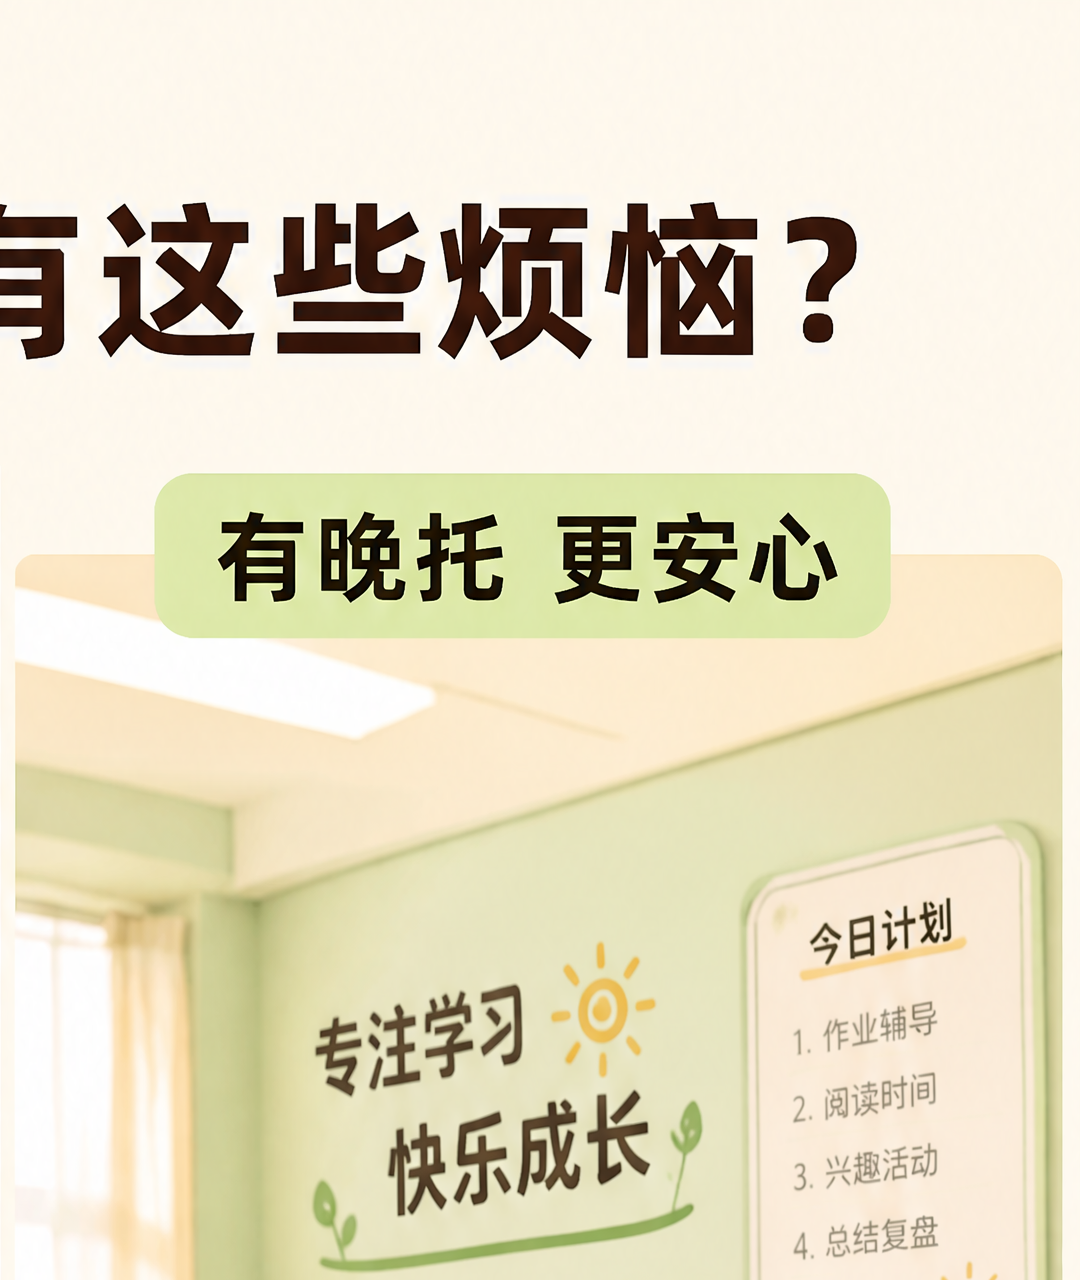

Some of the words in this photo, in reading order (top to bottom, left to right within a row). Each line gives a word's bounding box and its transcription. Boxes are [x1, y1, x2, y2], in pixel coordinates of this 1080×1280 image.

[810, 897, 952, 965] 今日计划
[314, 984, 524, 1098] 专注学习
[792, 1028, 812, 1056] 1.
[822, 1000, 938, 1053] 作业辅导
[792, 1094, 813, 1123] 2.
[824, 1071, 937, 1121] 阅读时间
[387, 1089, 652, 1218] 快乐成长
[793, 1162, 814, 1192] 3.
[825, 1142, 939, 1190] 兴趣活动
[792, 1231, 815, 1261] 4.
[825, 1214, 939, 1258] 总结复盘
